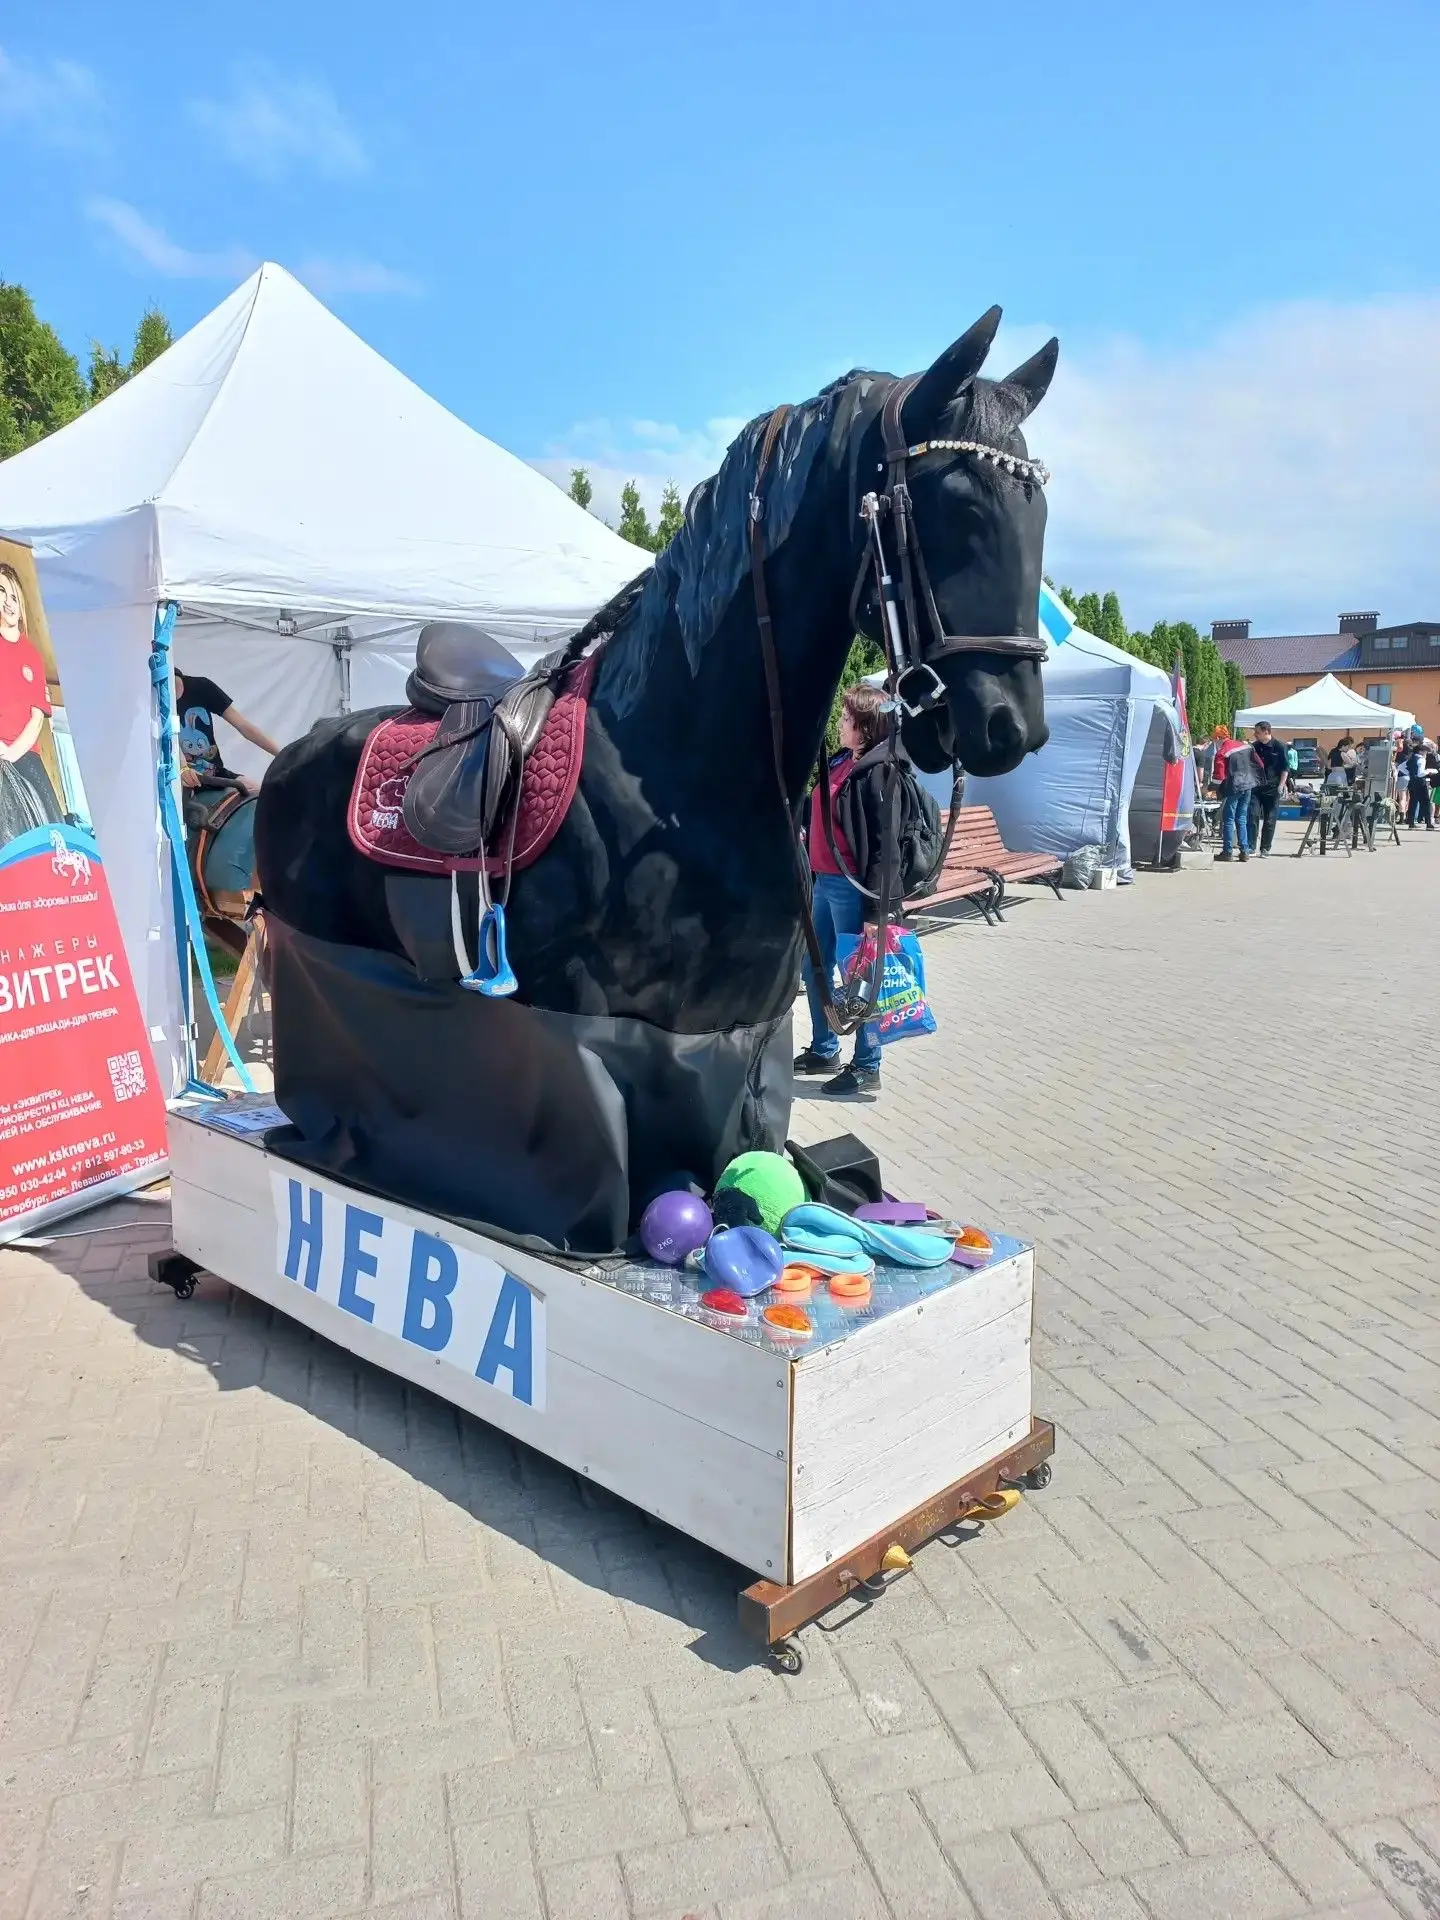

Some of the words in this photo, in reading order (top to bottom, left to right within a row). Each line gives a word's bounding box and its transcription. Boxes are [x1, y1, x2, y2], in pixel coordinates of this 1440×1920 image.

[17, 900, 31, 910] для
[0, 935, 98, 964] НАЖЕРЫ
[880, 978, 907, 988] анк
[892, 1002, 926, 1024] OZON
[70, 1090, 95, 1104] НЕВА
[19, 1122, 34, 1135] НА
[35, 1100, 102, 1129] ОБСЛУЖИВАНИЕ
[12, 1131, 116, 1176] www.kskneva.ru
[20, 1168, 67, 1192] 030-42-04
[70, 1162, 84, 1173] +7
[84, 1154, 102, 1168] 812
[51, 1186, 69, 1200] пос.
[284, 1178, 532, 1406] НЕВА
